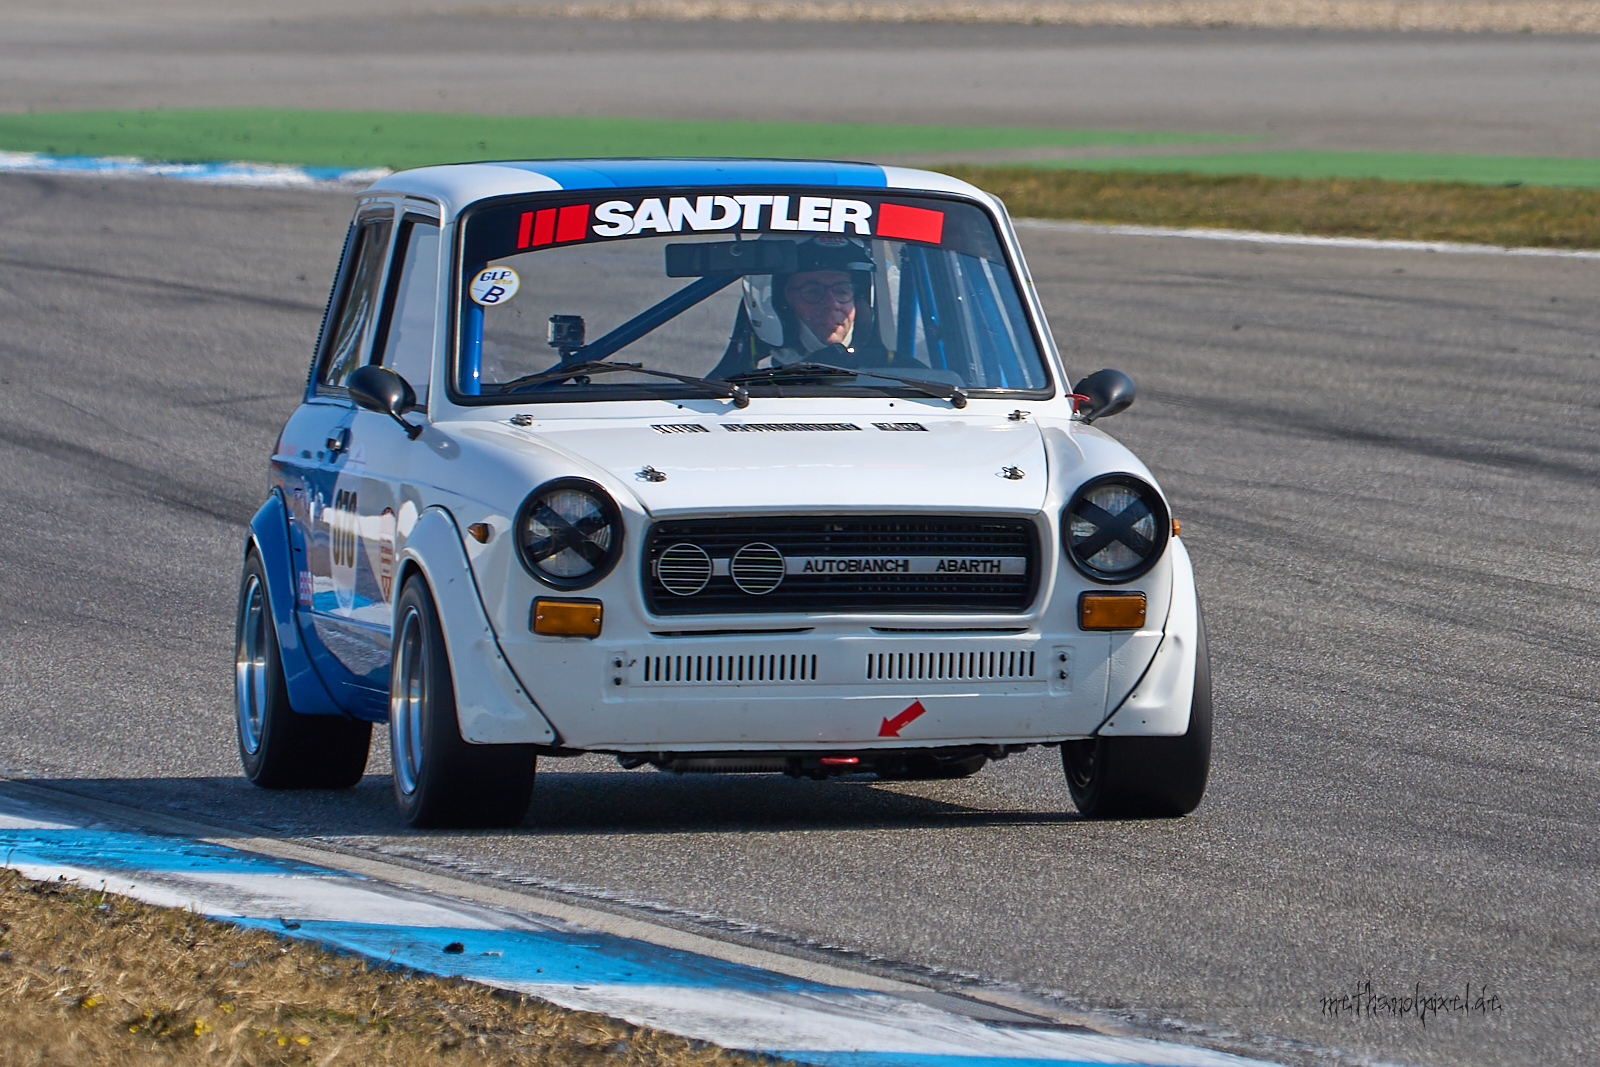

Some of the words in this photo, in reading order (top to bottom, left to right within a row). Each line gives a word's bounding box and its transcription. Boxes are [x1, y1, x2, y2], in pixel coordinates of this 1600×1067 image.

[592, 195, 872, 238] SANDTLER
[818, 236, 846, 244] BELL
[480, 271, 512, 282] GLP
[480, 286, 506, 303] B
[803, 559, 909, 573] AUTOBIANCHI
[935, 559, 1002, 573] ABARTH
